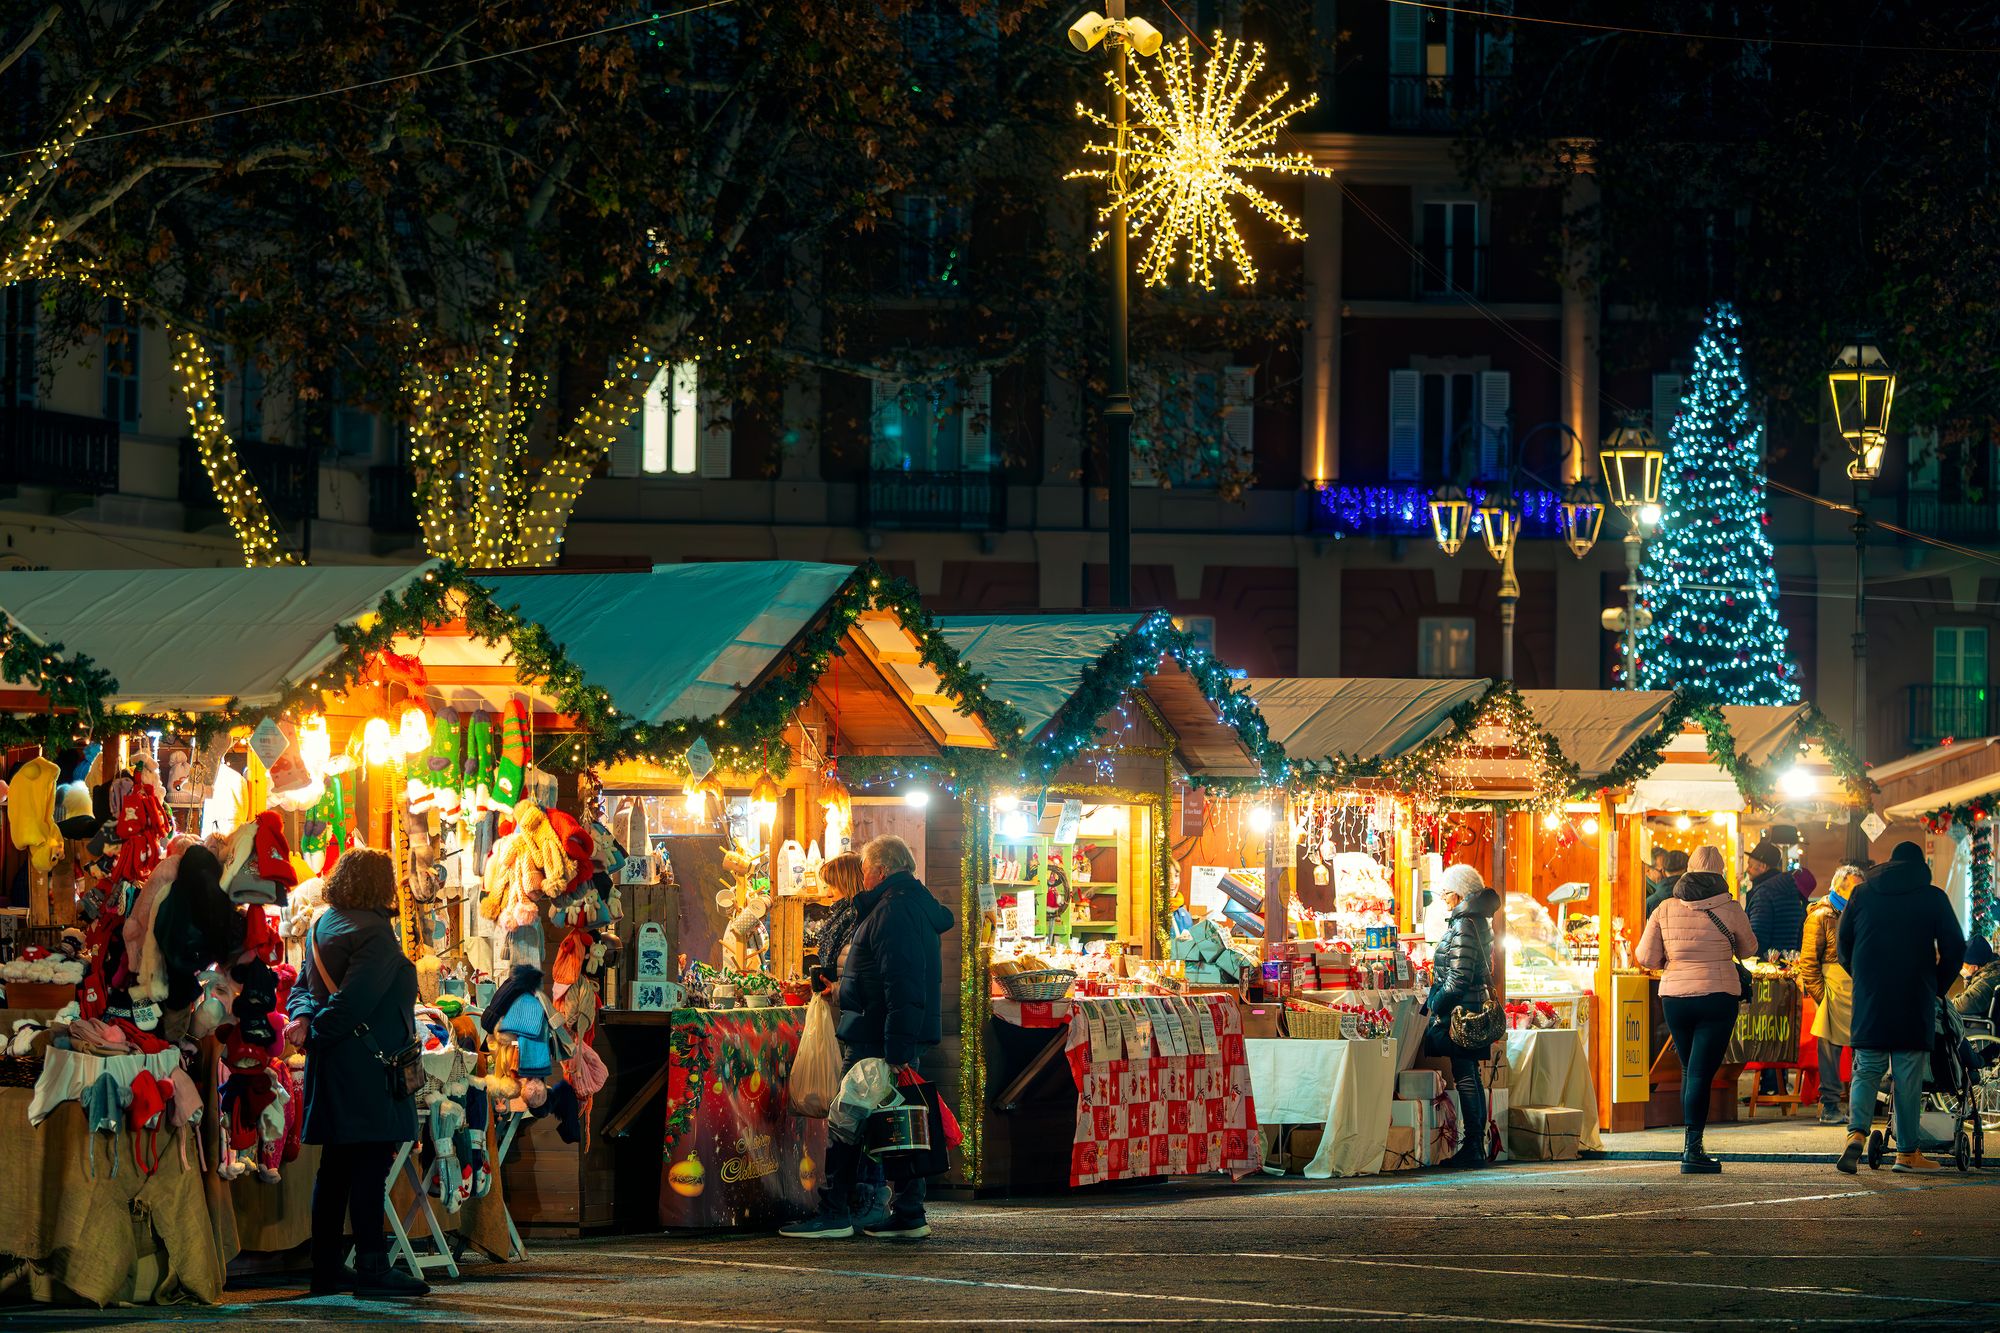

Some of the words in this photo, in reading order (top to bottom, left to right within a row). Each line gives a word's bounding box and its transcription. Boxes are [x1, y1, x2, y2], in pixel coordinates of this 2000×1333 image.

[1757, 979, 1773, 1003] DEL
[1625, 1013, 1640, 1042] tino
[1731, 1013, 1790, 1042] TELMAGNO
